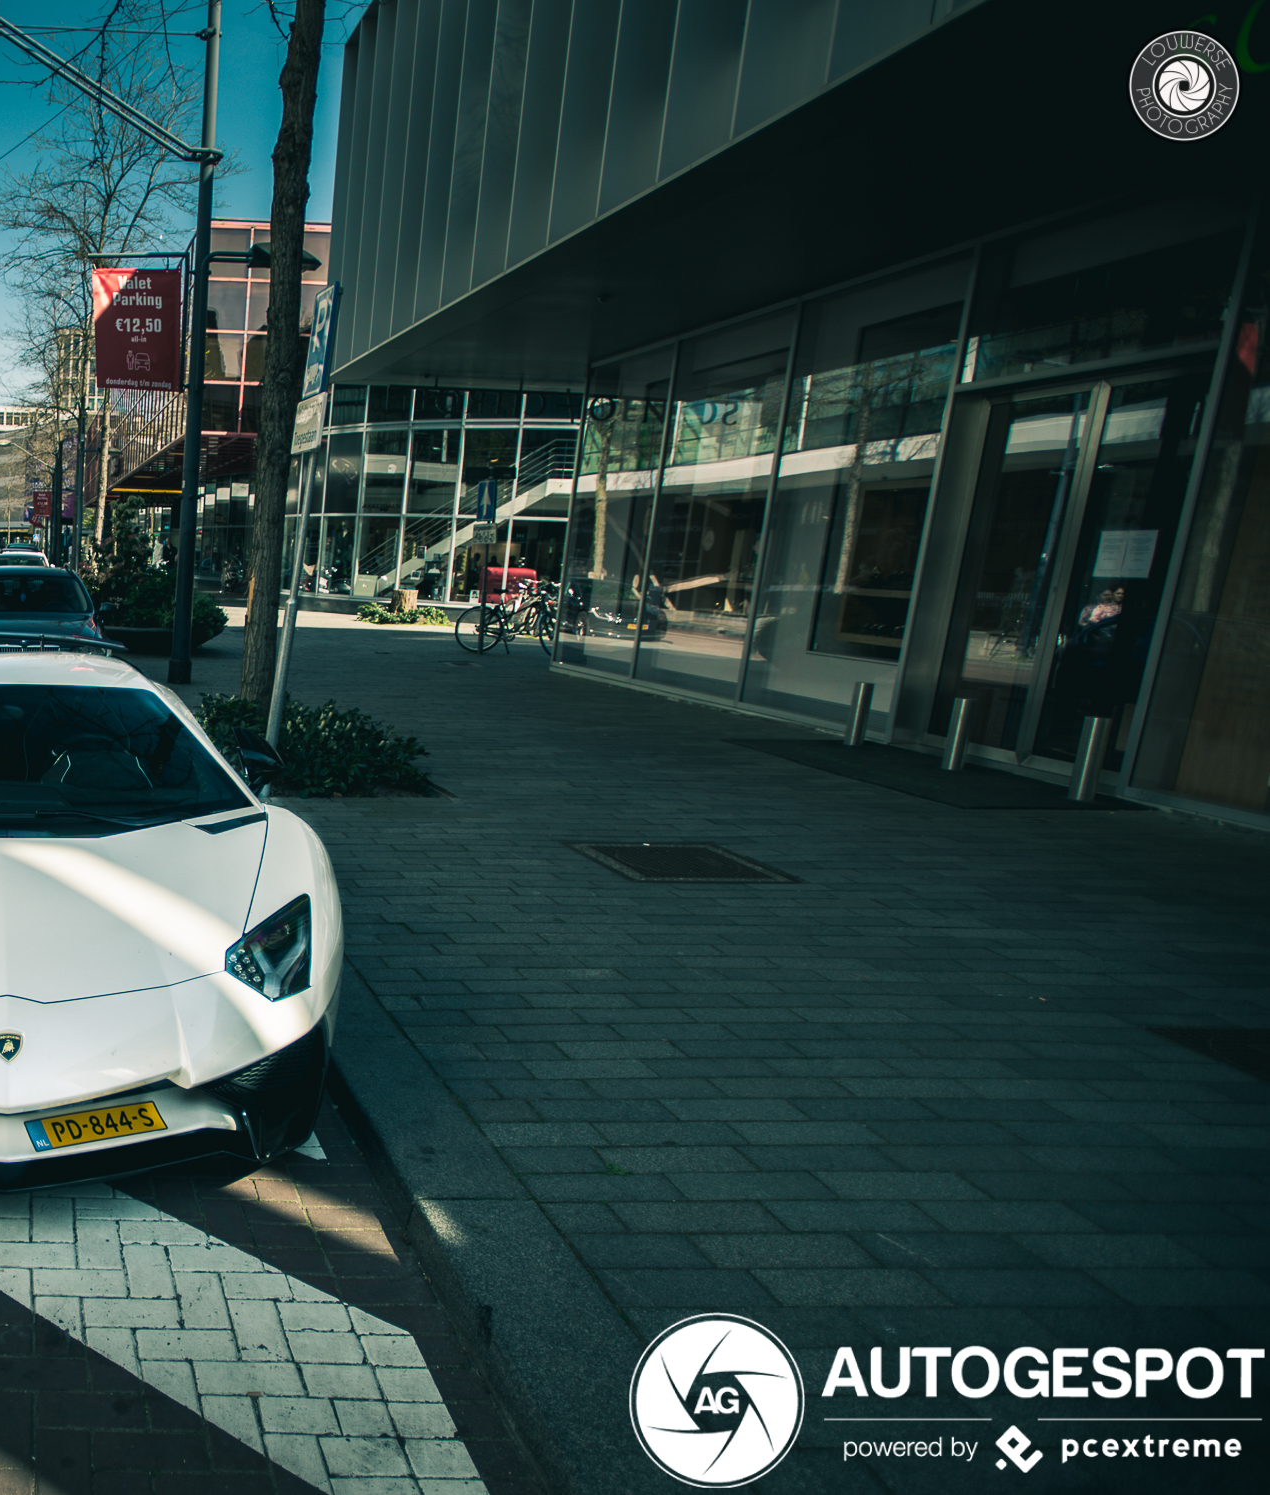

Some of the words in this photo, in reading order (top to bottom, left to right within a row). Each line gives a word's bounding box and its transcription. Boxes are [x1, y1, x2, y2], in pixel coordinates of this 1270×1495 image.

[117, 276, 152, 290] Valet
[112, 292, 162, 309] Parking
[115, 318, 162, 334] €12,50
[105, 377, 139, 388] donderdag
[139, 379, 150, 387] t/m
[151, 380, 172, 390] zondag
[51, 1107, 155, 1142] PD-844-S
[36, 1139, 50, 1148] NL
